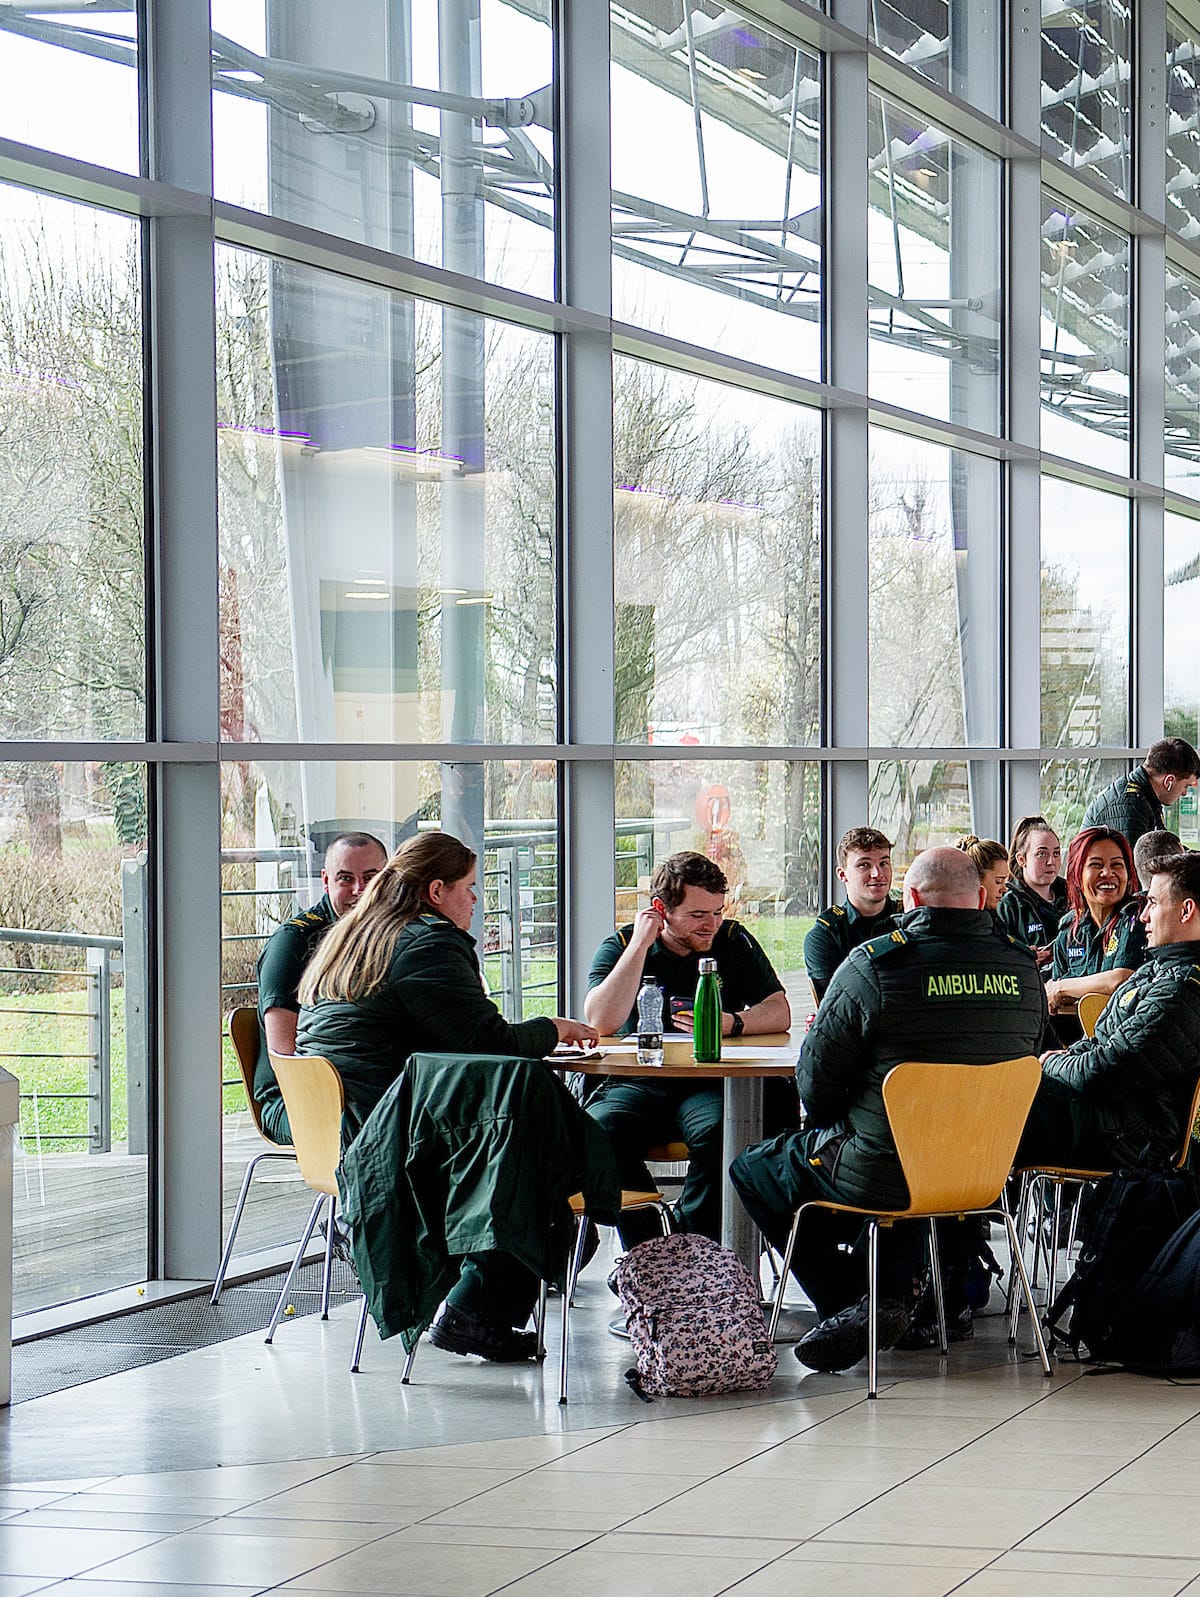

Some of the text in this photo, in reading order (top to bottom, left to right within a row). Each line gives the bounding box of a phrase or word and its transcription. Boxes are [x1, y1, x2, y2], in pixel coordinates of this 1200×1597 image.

[1028, 924, 1043, 933] NHS
[1068, 948, 1083, 957] NHS
[927, 974, 1020, 996] AMBULANCE
